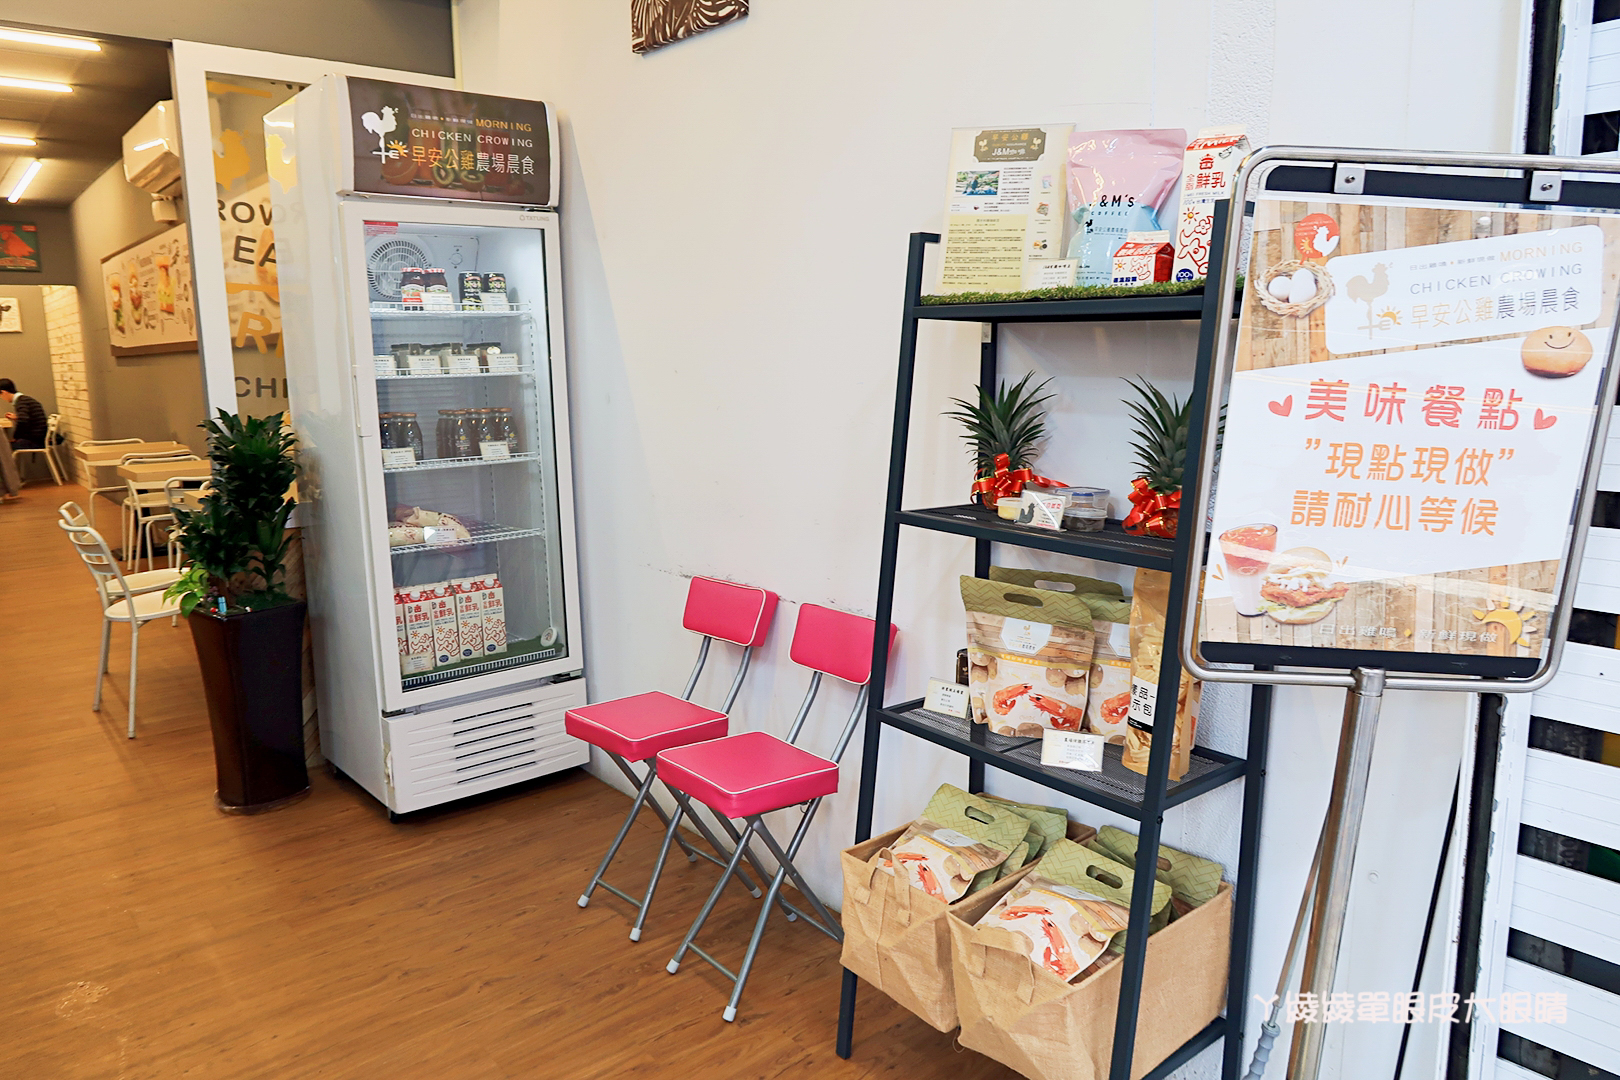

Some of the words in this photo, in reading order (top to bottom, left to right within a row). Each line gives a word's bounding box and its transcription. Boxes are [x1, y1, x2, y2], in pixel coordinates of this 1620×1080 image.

[411, 128, 472, 143] CHICKEN
[477, 135, 533, 148] CROWING
[475, 118, 532, 132] MORNING
[411, 145, 535, 176] 早安公雞農場晨食
[1195, 171, 1226, 189] 鮮乳
[1500, 241, 1583, 262] MORNING
[1409, 274, 1492, 295] CHICKEN
[1500, 263, 1582, 284] CROWING
[1411, 286, 1581, 329] 早安公雞農場晨食
[1304, 378, 1524, 431] 美味餐點
[1290, 489, 1499, 537] 請耐心等候
